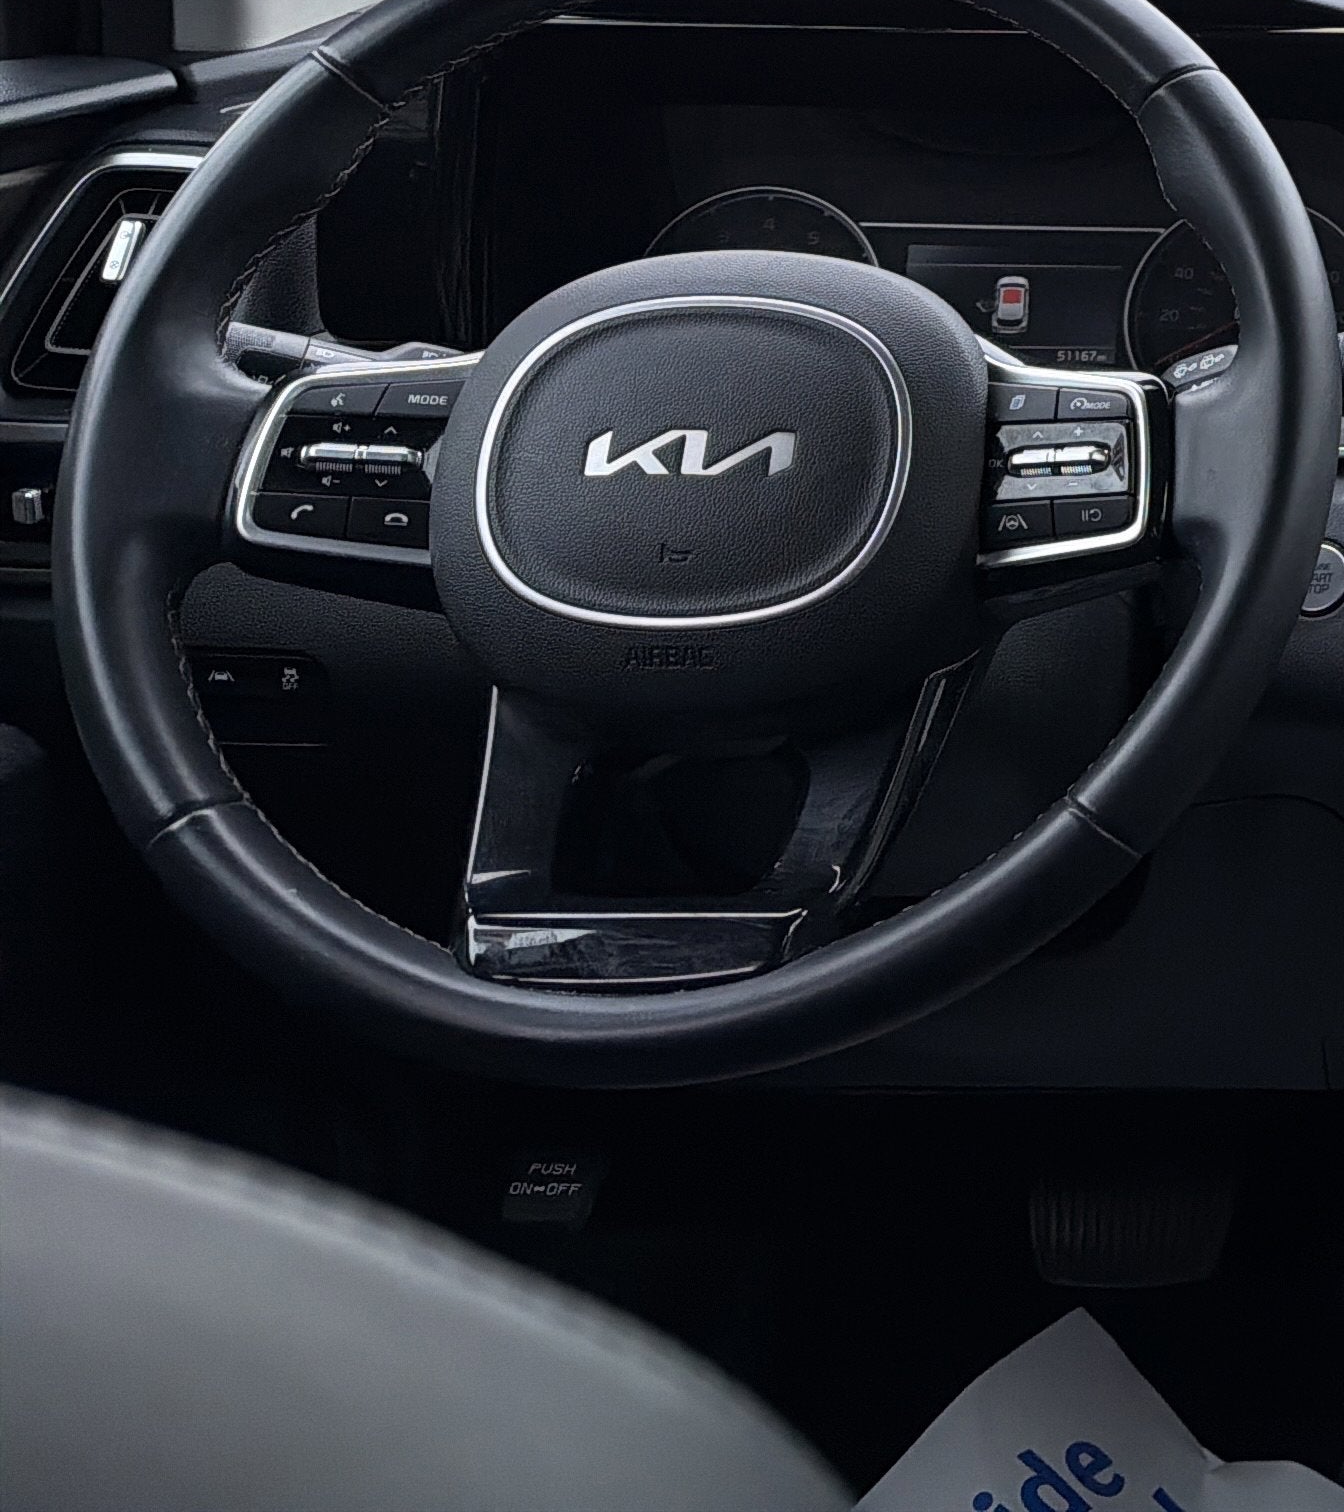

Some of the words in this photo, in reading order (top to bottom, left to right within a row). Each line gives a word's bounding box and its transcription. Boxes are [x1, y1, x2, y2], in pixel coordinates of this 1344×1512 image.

[1173, 266, 1195, 281] 40
[1158, 308, 1180, 323] 20
[1056, 349, 1098, 362] 51167
[407, 394, 449, 406] MODE
[1085, 401, 1111, 410] MODE
[584, 429, 797, 476] KIA
[988, 458, 1004, 468] OK
[527, 1162, 578, 1176] PUSH
